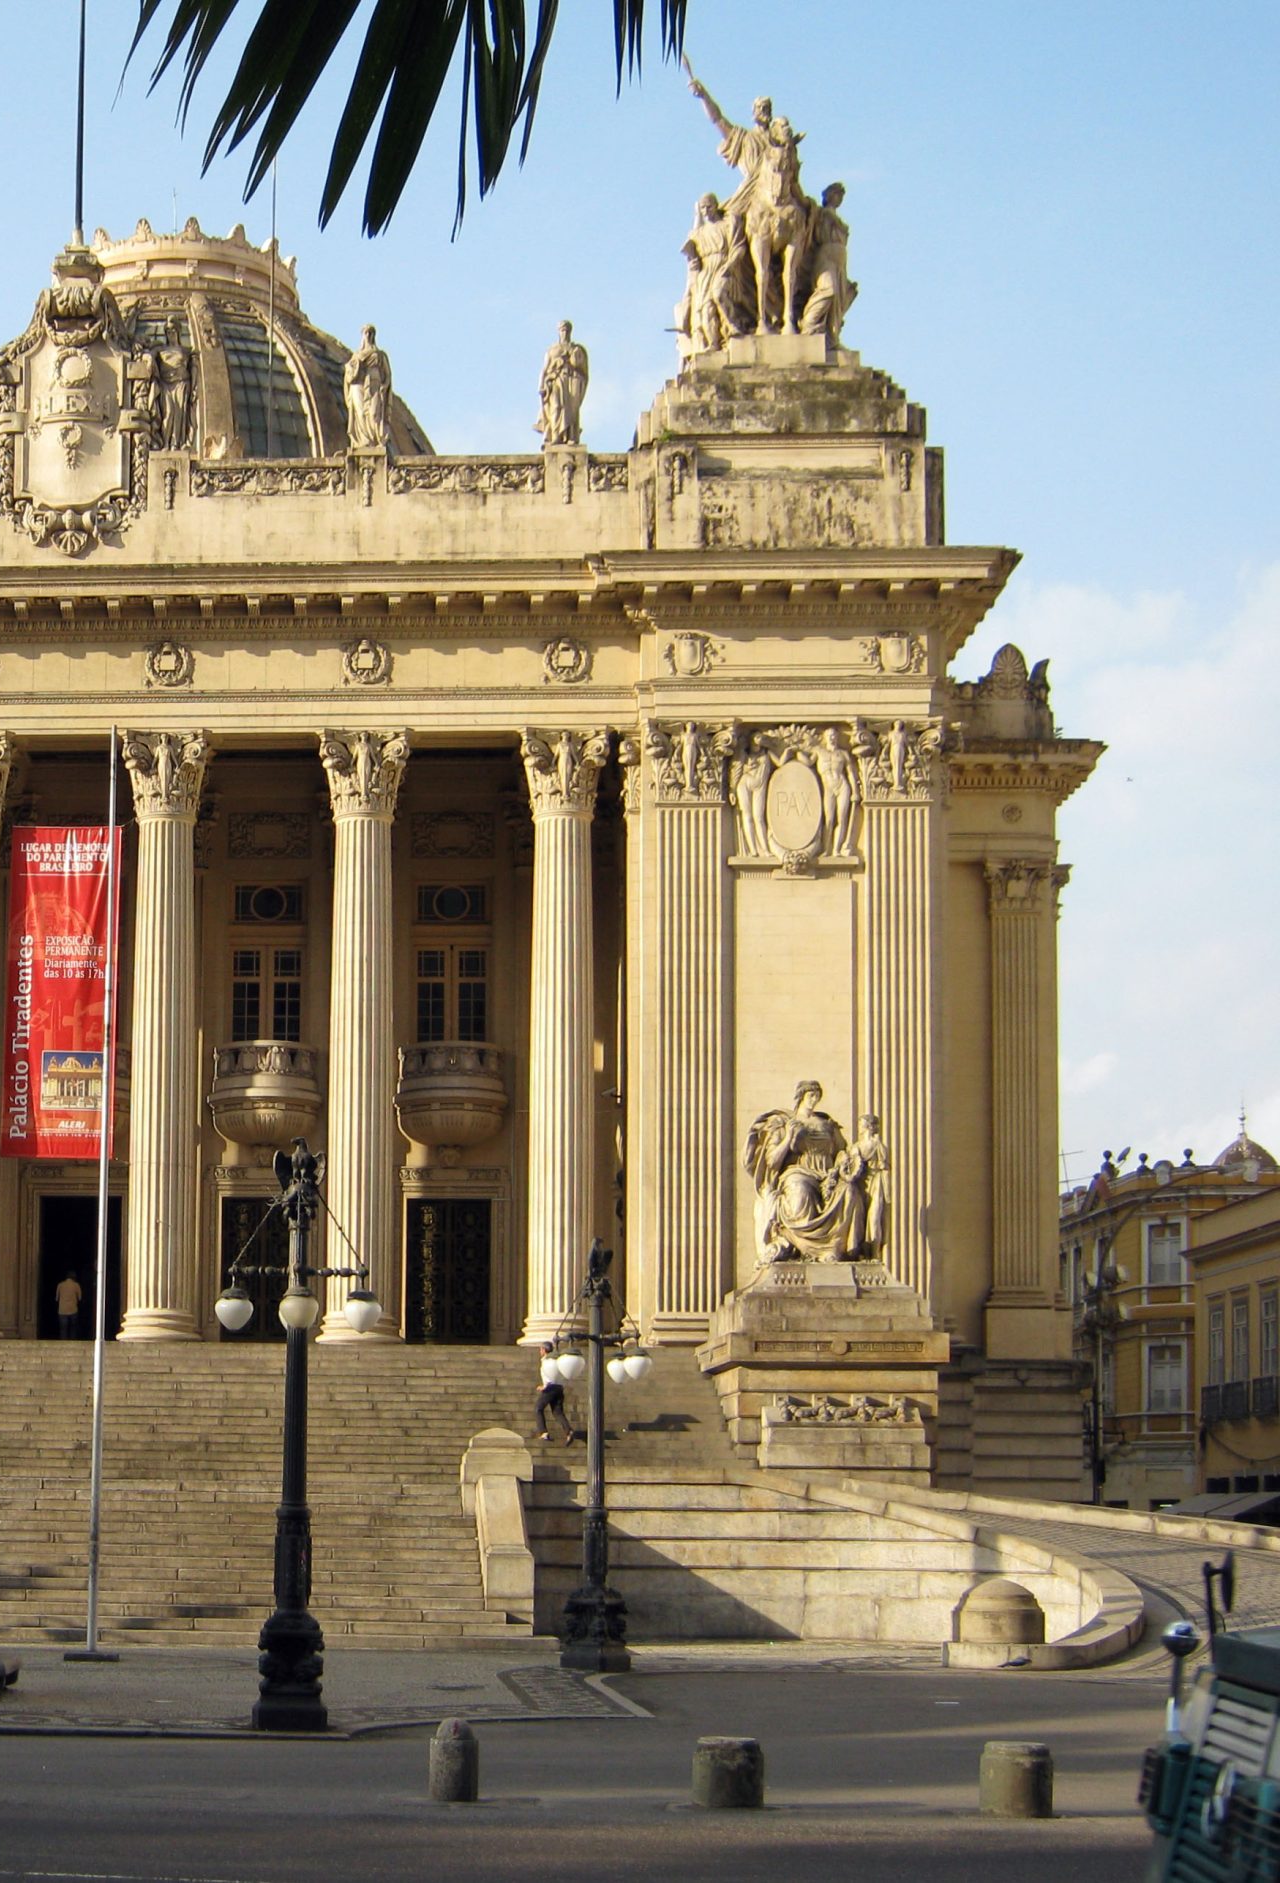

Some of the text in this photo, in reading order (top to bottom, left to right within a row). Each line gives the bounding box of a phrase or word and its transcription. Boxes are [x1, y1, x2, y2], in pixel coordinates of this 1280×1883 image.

[776, 792, 812, 817] PAX
[21, 843, 52, 852] LUGAR
[54, 843, 67, 852] DE
[27, 852, 41, 862] DO
[45, 934, 94, 946] EXPOSIÇÃO
[45, 946, 104, 956] PERMANENTE
[44, 958, 98, 968] Diariamente
[43, 968, 60, 978] das
[63, 968, 73, 978] 10
[9, 935, 33, 1139] Palácio Tiradentes
[57, 1120, 86, 1129] ALERJ
